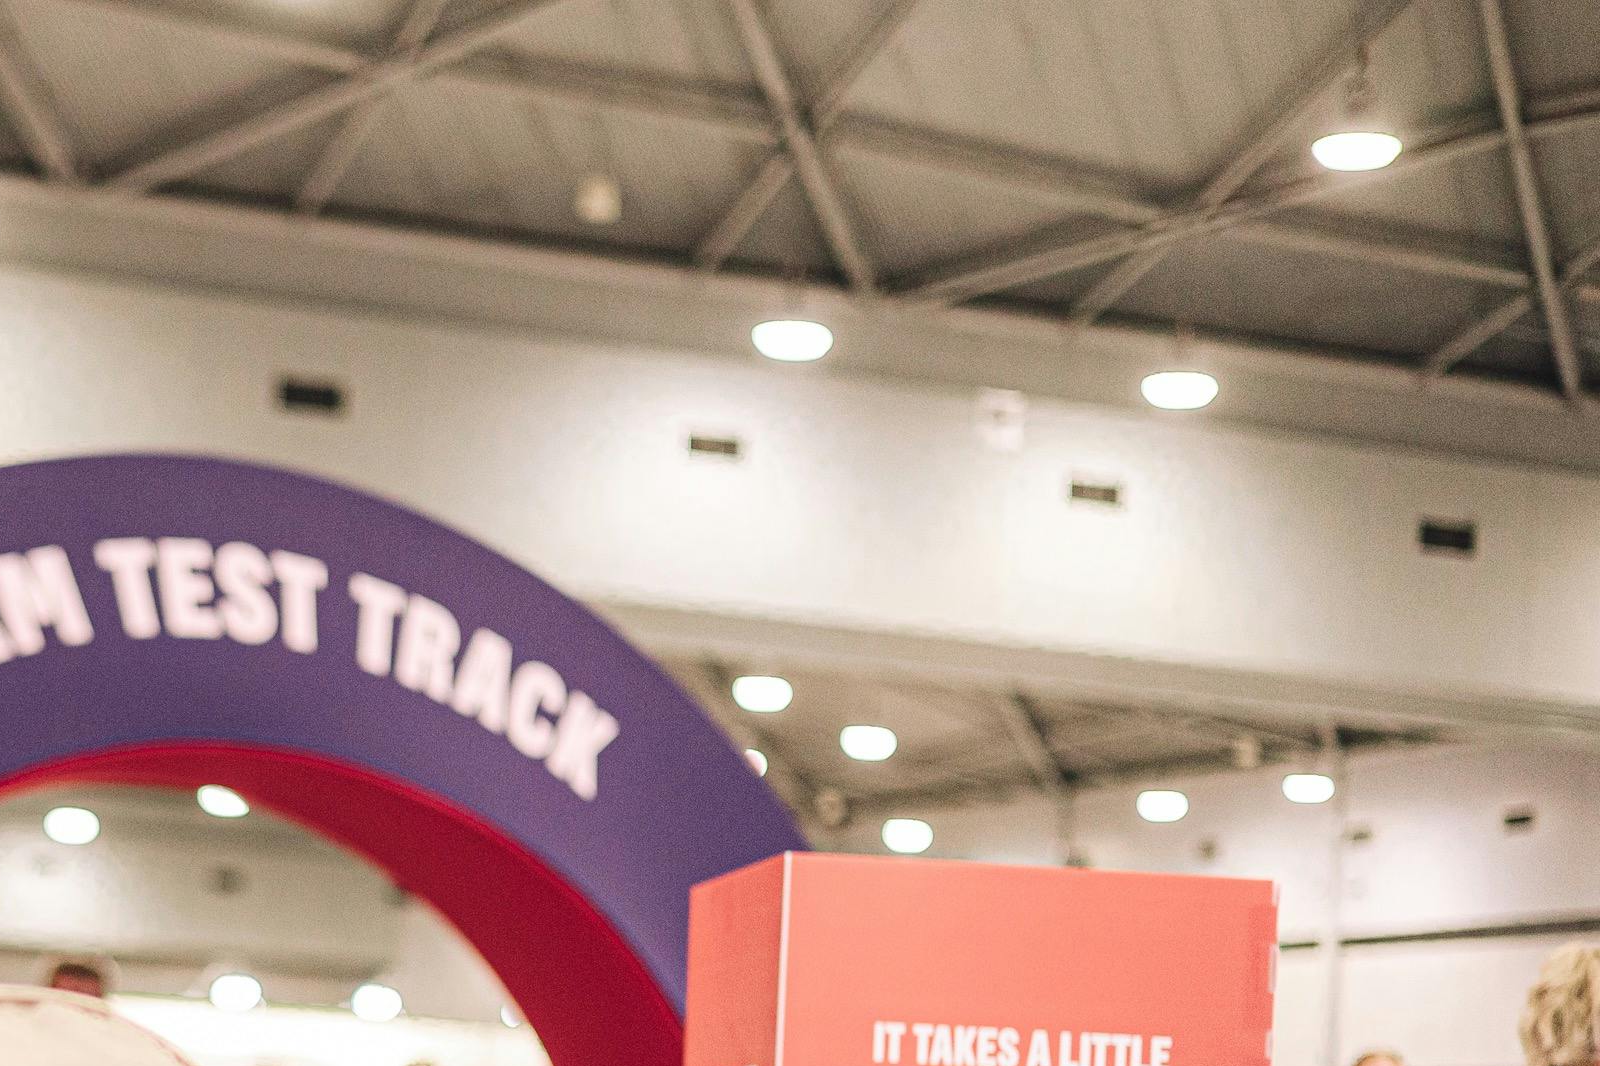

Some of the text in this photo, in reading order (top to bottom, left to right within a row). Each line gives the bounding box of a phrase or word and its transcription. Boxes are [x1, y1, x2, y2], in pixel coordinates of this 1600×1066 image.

[93, 536, 329, 655] TEST
[348, 571, 621, 801] TRACK
[871, 1020, 908, 1065] IT
